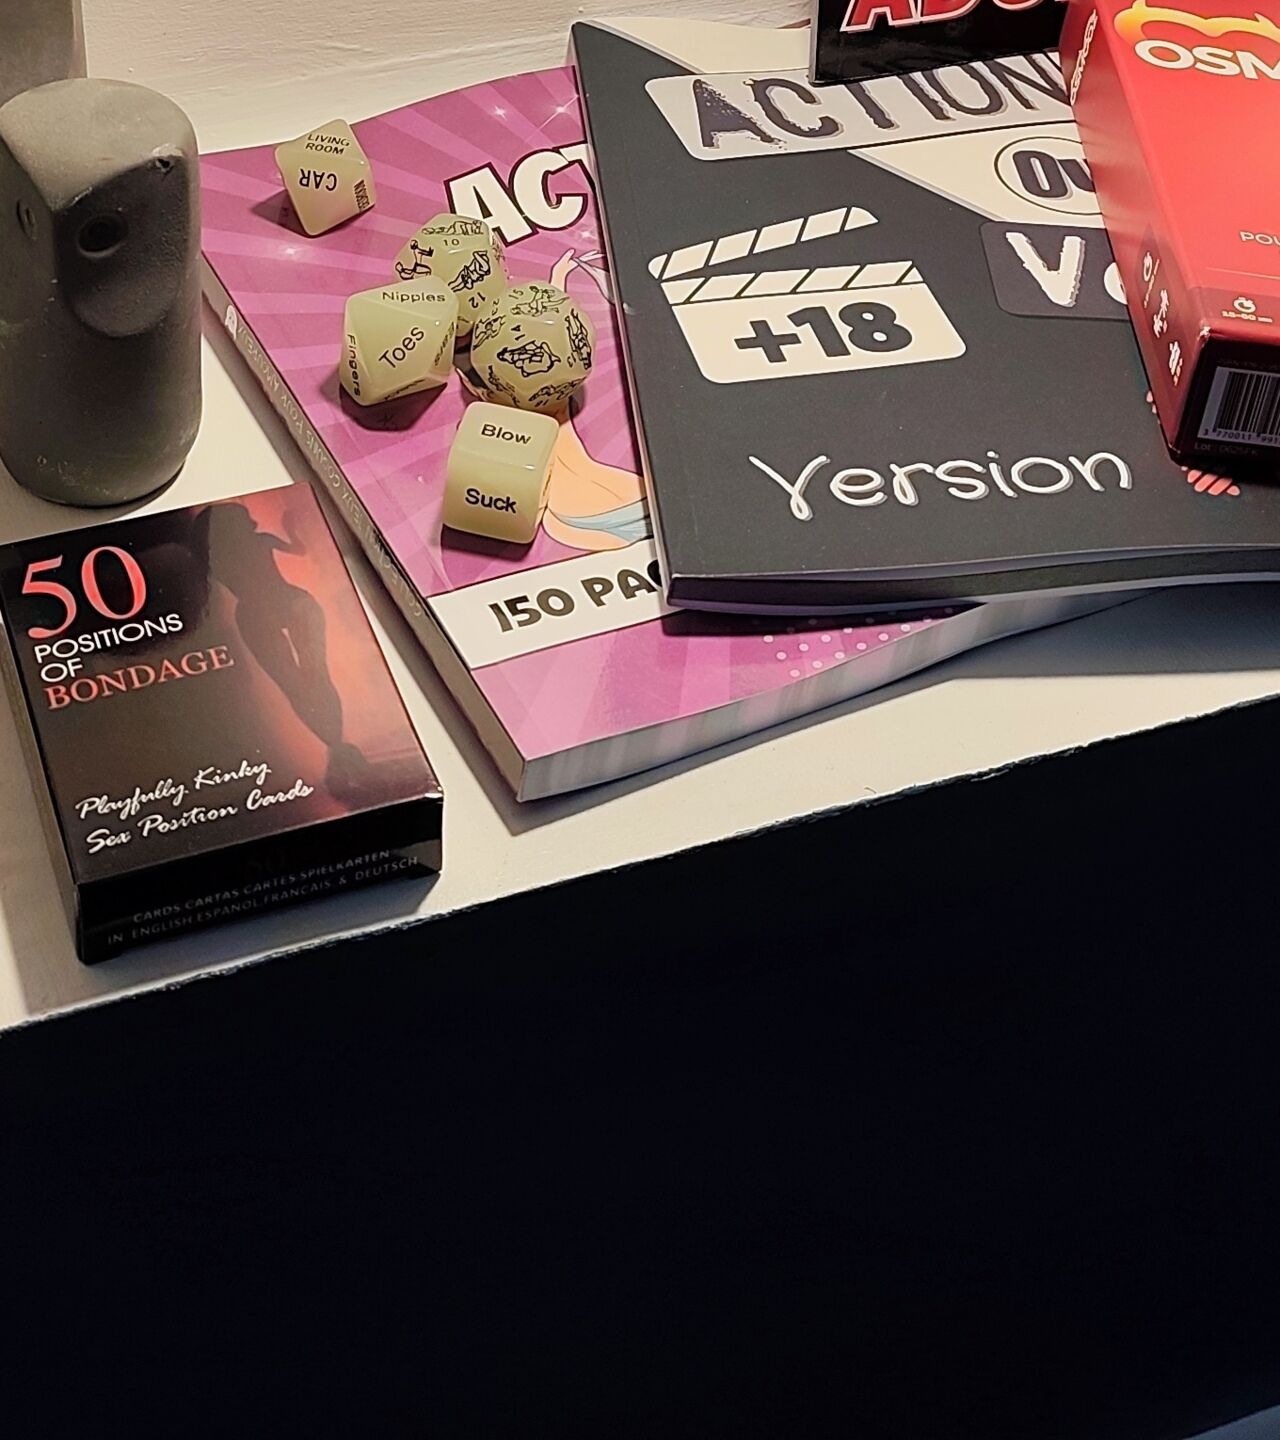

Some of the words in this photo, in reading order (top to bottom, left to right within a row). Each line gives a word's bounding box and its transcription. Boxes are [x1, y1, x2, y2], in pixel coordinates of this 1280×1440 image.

[305, 142, 345, 155] ROOM
[307, 134, 350, 147] LIVING
[299, 168, 337, 192] CAR
[381, 291, 446, 304] Nipples
[467, 291, 487, 309] 12
[378, 325, 425, 370] Toes
[734, 301, 914, 363] +18
[346, 333, 361, 397] Fingers
[481, 423, 532, 445] Blow
[465, 487, 517, 514] Suck
[20, 545, 149, 641] 50
[488, 588, 575, 633] 150
[33, 612, 184, 665] POSITIONS
[40, 658, 85, 685] OF
[43, 644, 236, 711] BONDAGE
[75, 782, 190, 821] Playfully
[193, 758, 273, 793] Kinky
[85, 827, 132, 856] Sex
[137, 802, 238, 841] Position
[246, 780, 315, 809] Cards
[107, 933, 124, 946] IN
[355, 855, 419, 881] DEUTSCH
